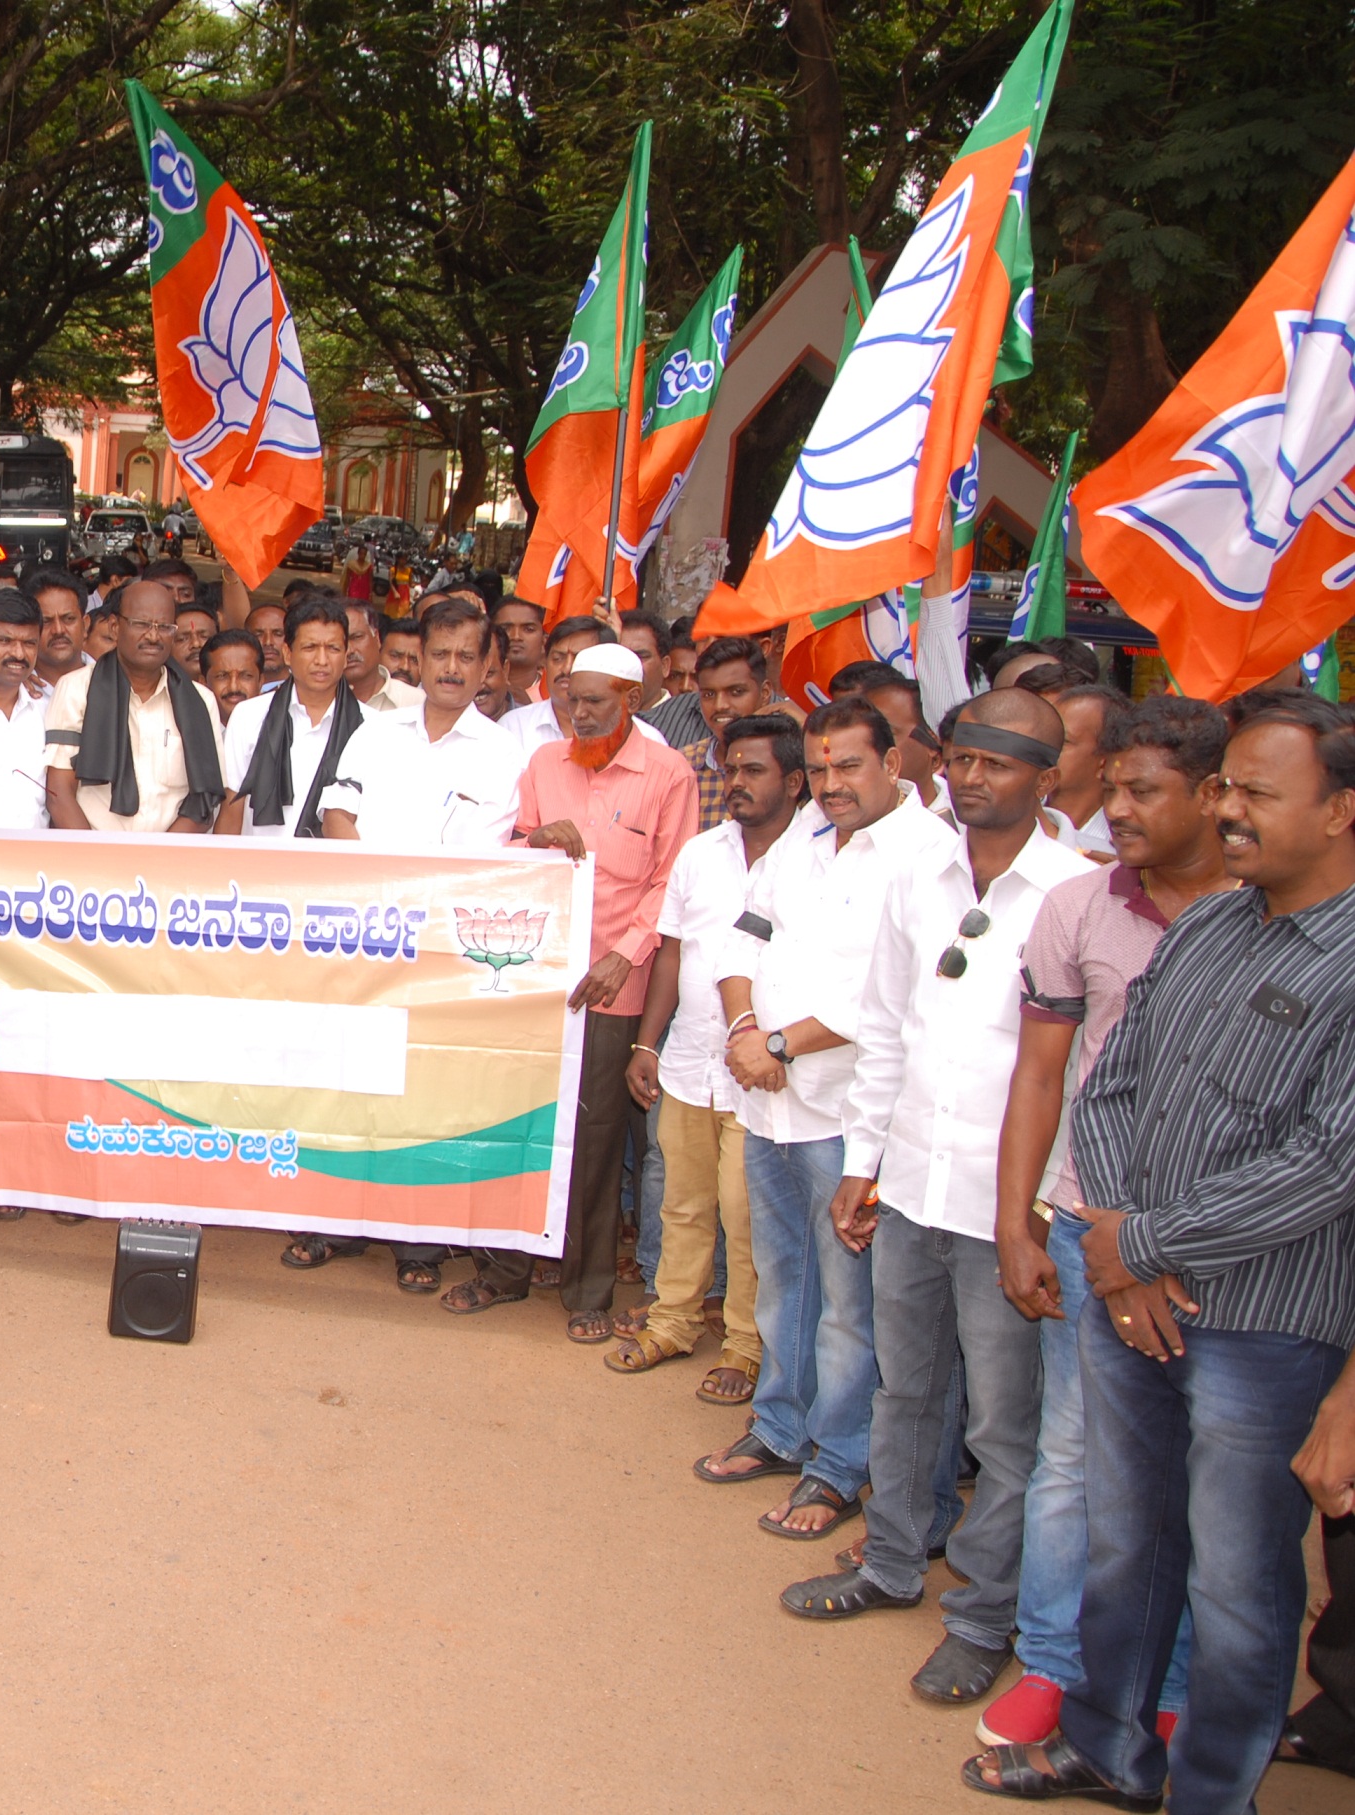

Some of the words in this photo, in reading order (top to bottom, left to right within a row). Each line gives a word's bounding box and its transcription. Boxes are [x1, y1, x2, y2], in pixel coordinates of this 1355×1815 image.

[167, 883, 292, 951] ಜನತಾ
[303, 903, 427, 959] ಪಾರ್ಟಿ
[66, 1115, 232, 1160] ತುಮಕೂರು
[238, 1129, 298, 1178] ಜಿಲ್ಲೆ
